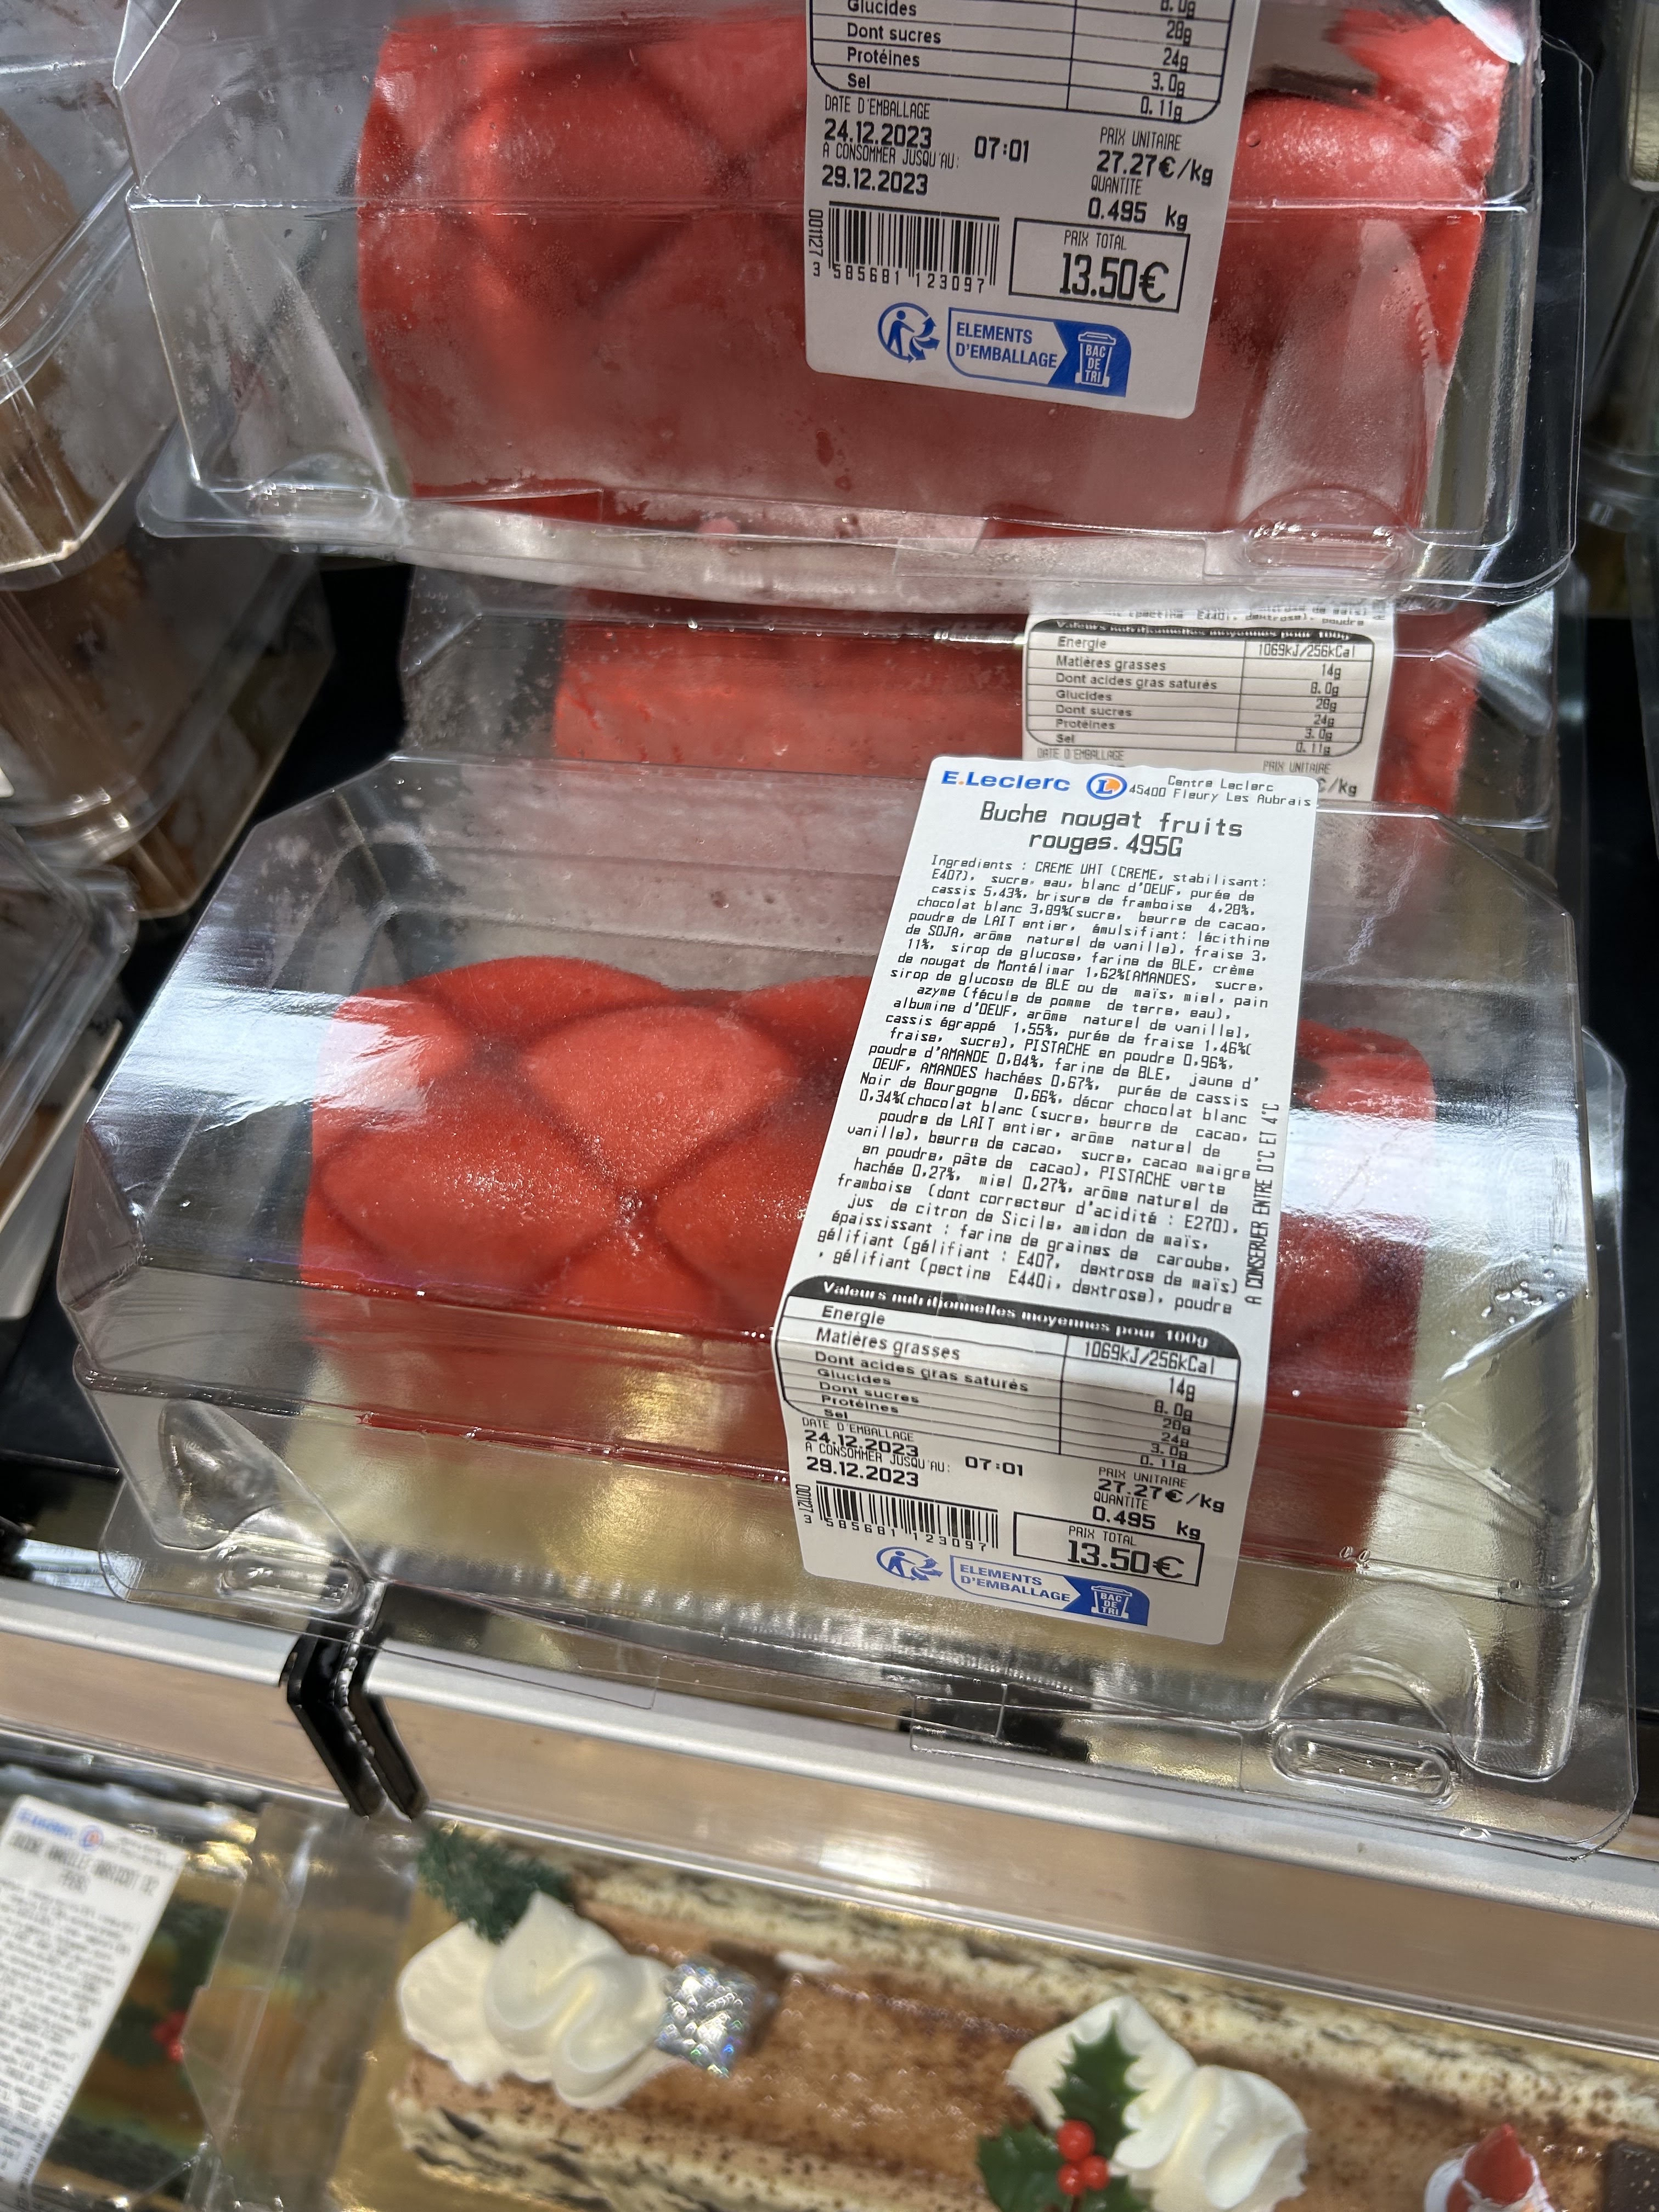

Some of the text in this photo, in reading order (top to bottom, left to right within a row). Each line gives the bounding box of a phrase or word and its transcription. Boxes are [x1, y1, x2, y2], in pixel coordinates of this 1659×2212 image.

[848, 0, 917, 16] Glucides
[847, 21, 941, 44] Dont sucres
[1165, 18, 1192, 43] 28g
[847, 46, 919, 67] Protéines
[1162, 46, 1189, 70] 24g
[847, 72, 870, 90] Sel
[825, 93, 930, 120] DATE D'EMBALLAGE
[823, 117, 932, 150] 24.12.2023
[1099, 126, 1182, 151] PRIX UNITAIRE
[822, 140, 959, 170] A CONSOMMER JUSQU'AU:
[974, 135, 1029, 163] 07:01
[821, 163, 928, 196] 29.12.2023
[1094, 149, 1214, 187] 27.27€/kg
[1090, 174, 1143, 195] QUANTITE
[1087, 196, 1188, 232] 0.495 kg
[808, 208, 823, 257] 001127
[1063, 229, 1127, 251] PRIX TOTAL
[1059, 252, 1169, 303] 13.50€
[956, 321, 1032, 345] ELEMENTS
[955, 341, 1058, 369] D'EMBALLAGE
[1085, 343, 1106, 358] BAC
[1087, 357, 1101, 370] DE
[1084, 369, 1101, 383] TRI
[940, 770, 1070, 792] E.Leclerc
[1128, 783, 1311, 806] 45400 Fleury Les Aubrais
[1167, 775, 1274, 792] Centre Leclerc
[979, 800, 1243, 837] Buche nougat fruits
[1028, 832, 1183, 857] rouges. 495G
[930, 854, 1013, 871] Ingredients
[1034, 860, 1074, 874] CREME
[1079, 862, 1104, 876] UHT
[1172, 872, 1266, 887] stabilisant:
[930, 885, 977, 896] cassis
[1035, 888, 1090, 904] brisure
[1097, 893, 1114, 906] de
[1121, 895, 1192, 912] framboise
[907, 910, 1269, 947] poudre de LAIT entier, émulsifiant: lécithine
[950, 942, 990, 957] sirop
[996, 944, 1013, 957] de
[1019, 946, 1081, 962] glucose,
[1091, 951, 1139, 966] farine
[1147, 956, 1164, 969] de
[1171, 957, 1203, 972] BLE,
[1212, 964, 1254, 977] crème
[916, 985, 1230, 1019] azyme (fécule de pomme de terre, eau),
[890, 1026, 943, 1042] fraise,
[959, 1035, 1014, 1049] sucre),
[1023, 1037, 1091, 1057] PISTACHE
[1098, 1049, 1115, 1059] en
[1122, 1049, 1175, 1065] poudre
[859, 1070, 891, 1086] Noir
[899, 1075, 917, 1088] de
[923, 1077, 998, 1098] Bourgogne
[1072, 1093, 1115, 1110] décor
[1123, 1098, 1193, 1119] chocolat
[1201, 1106, 1247, 1125] blanc
[1258, 1130, 1277, 1145] ET
[861, 1144, 879, 1155] en
[885, 1146, 943, 1161] poudre,
[995, 1154, 1013, 1170] de
[1029, 1161, 1088, 1177] cacao),
[1098, 1165, 1172, 1188] PISTACHE
[1180, 1180, 1226, 1195] verte
[1251, 1177, 1273, 1216] ENTRE
[1244, 1220, 1268, 1290] CONSERVER
[1244, 1295, 1262, 1305] A
[820, 1304, 888, 1331] Energie
[823, 1280, 886, 1301] Valeurs
[1020, 1311, 1109, 1331] moyennes
[1115, 1325, 1155, 1339] pour
[1166, 1329, 1209, 1348] 100g
[815, 1326, 960, 1361] Matières grasses
[815, 1350, 1028, 1392] Dont acides gras saturés
[1082, 1341, 1218, 1374] 1069kJ/256kCal
[819, 1380, 919, 1403] Dont sucres
[1169, 1376, 1195, 1402] 14g
[821, 1393, 899, 1413] Protéines
[804, 1429, 918, 1457] 24.12.2023
[806, 1455, 918, 1487] 29.12.2023
[964, 1455, 1023, 1477] 07:01
[1098, 1466, 1188, 1488] PRIX UNITAIRE
[1068, 1525, 1137, 1547] PRIX TOTAL
[1092, 1505, 1201, 1541] 0.495 kg
[1067, 1539, 1184, 1579] 13.50€
[960, 1563, 1042, 1585] ELEMENTS
